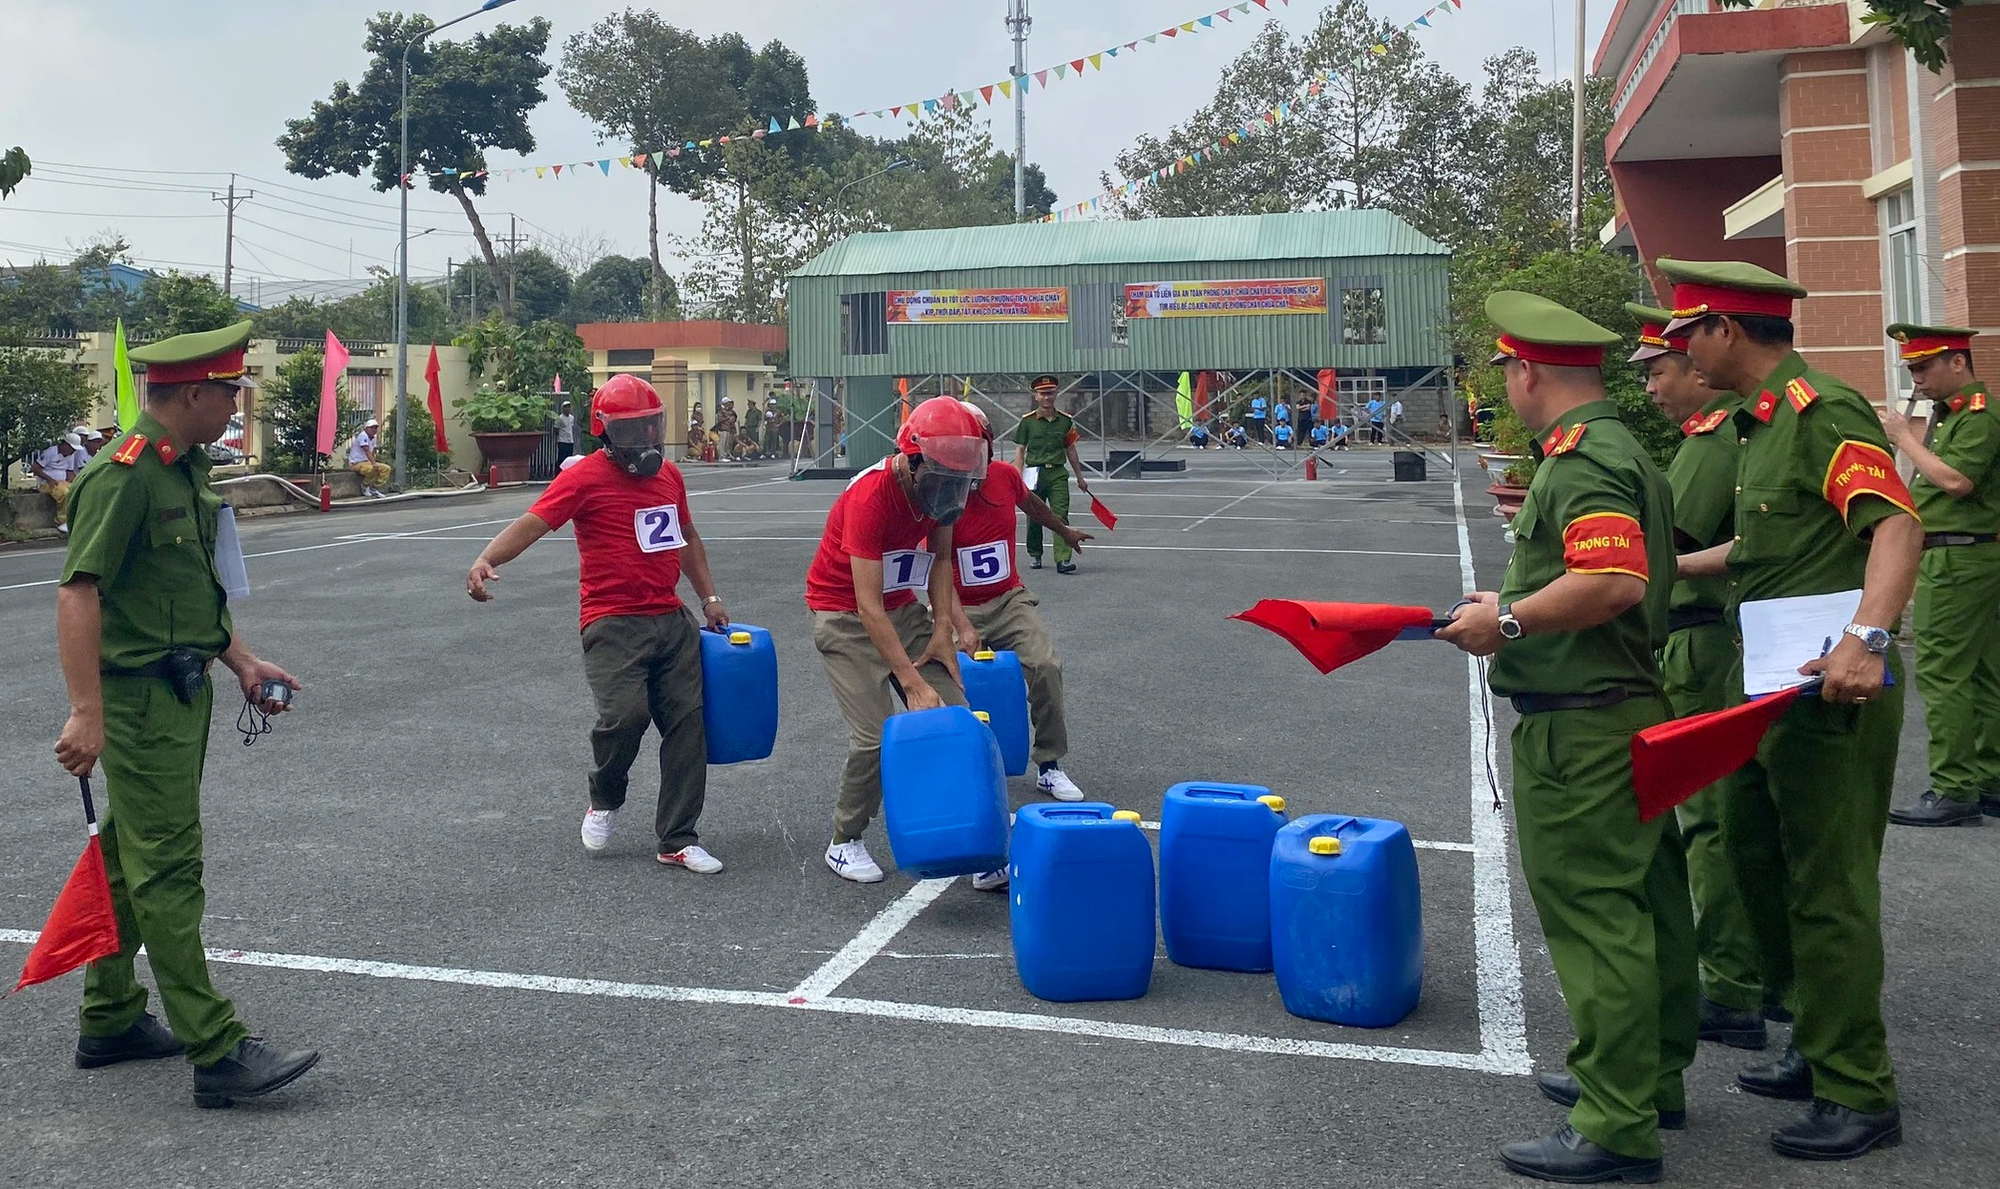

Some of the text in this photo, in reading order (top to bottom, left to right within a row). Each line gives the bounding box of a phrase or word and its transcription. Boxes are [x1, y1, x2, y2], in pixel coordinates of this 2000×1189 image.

[1867, 466, 1886, 480] TÀI
[645, 511, 674, 545] 2
[1573, 534, 1630, 552] TRỌNG TÀI
[892, 554, 915, 584] 1
[971, 547, 1000, 579] 5
